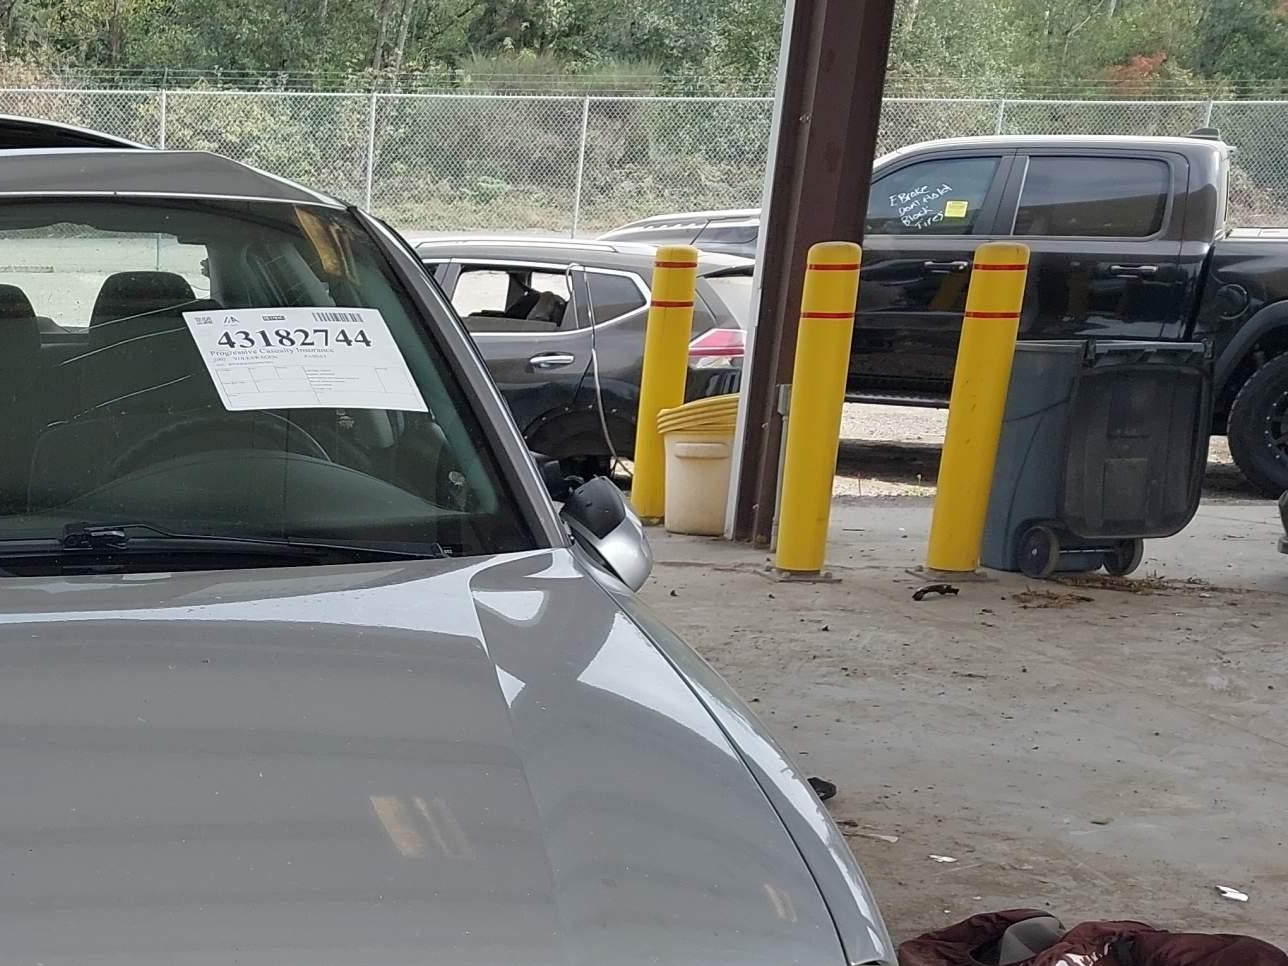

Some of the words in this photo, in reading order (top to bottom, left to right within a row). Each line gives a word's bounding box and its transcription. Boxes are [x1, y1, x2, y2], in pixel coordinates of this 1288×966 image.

[898, 185, 930, 203] Brake
[218, 328, 372, 349] 43182744
[210, 349, 258, 357] Progressive
